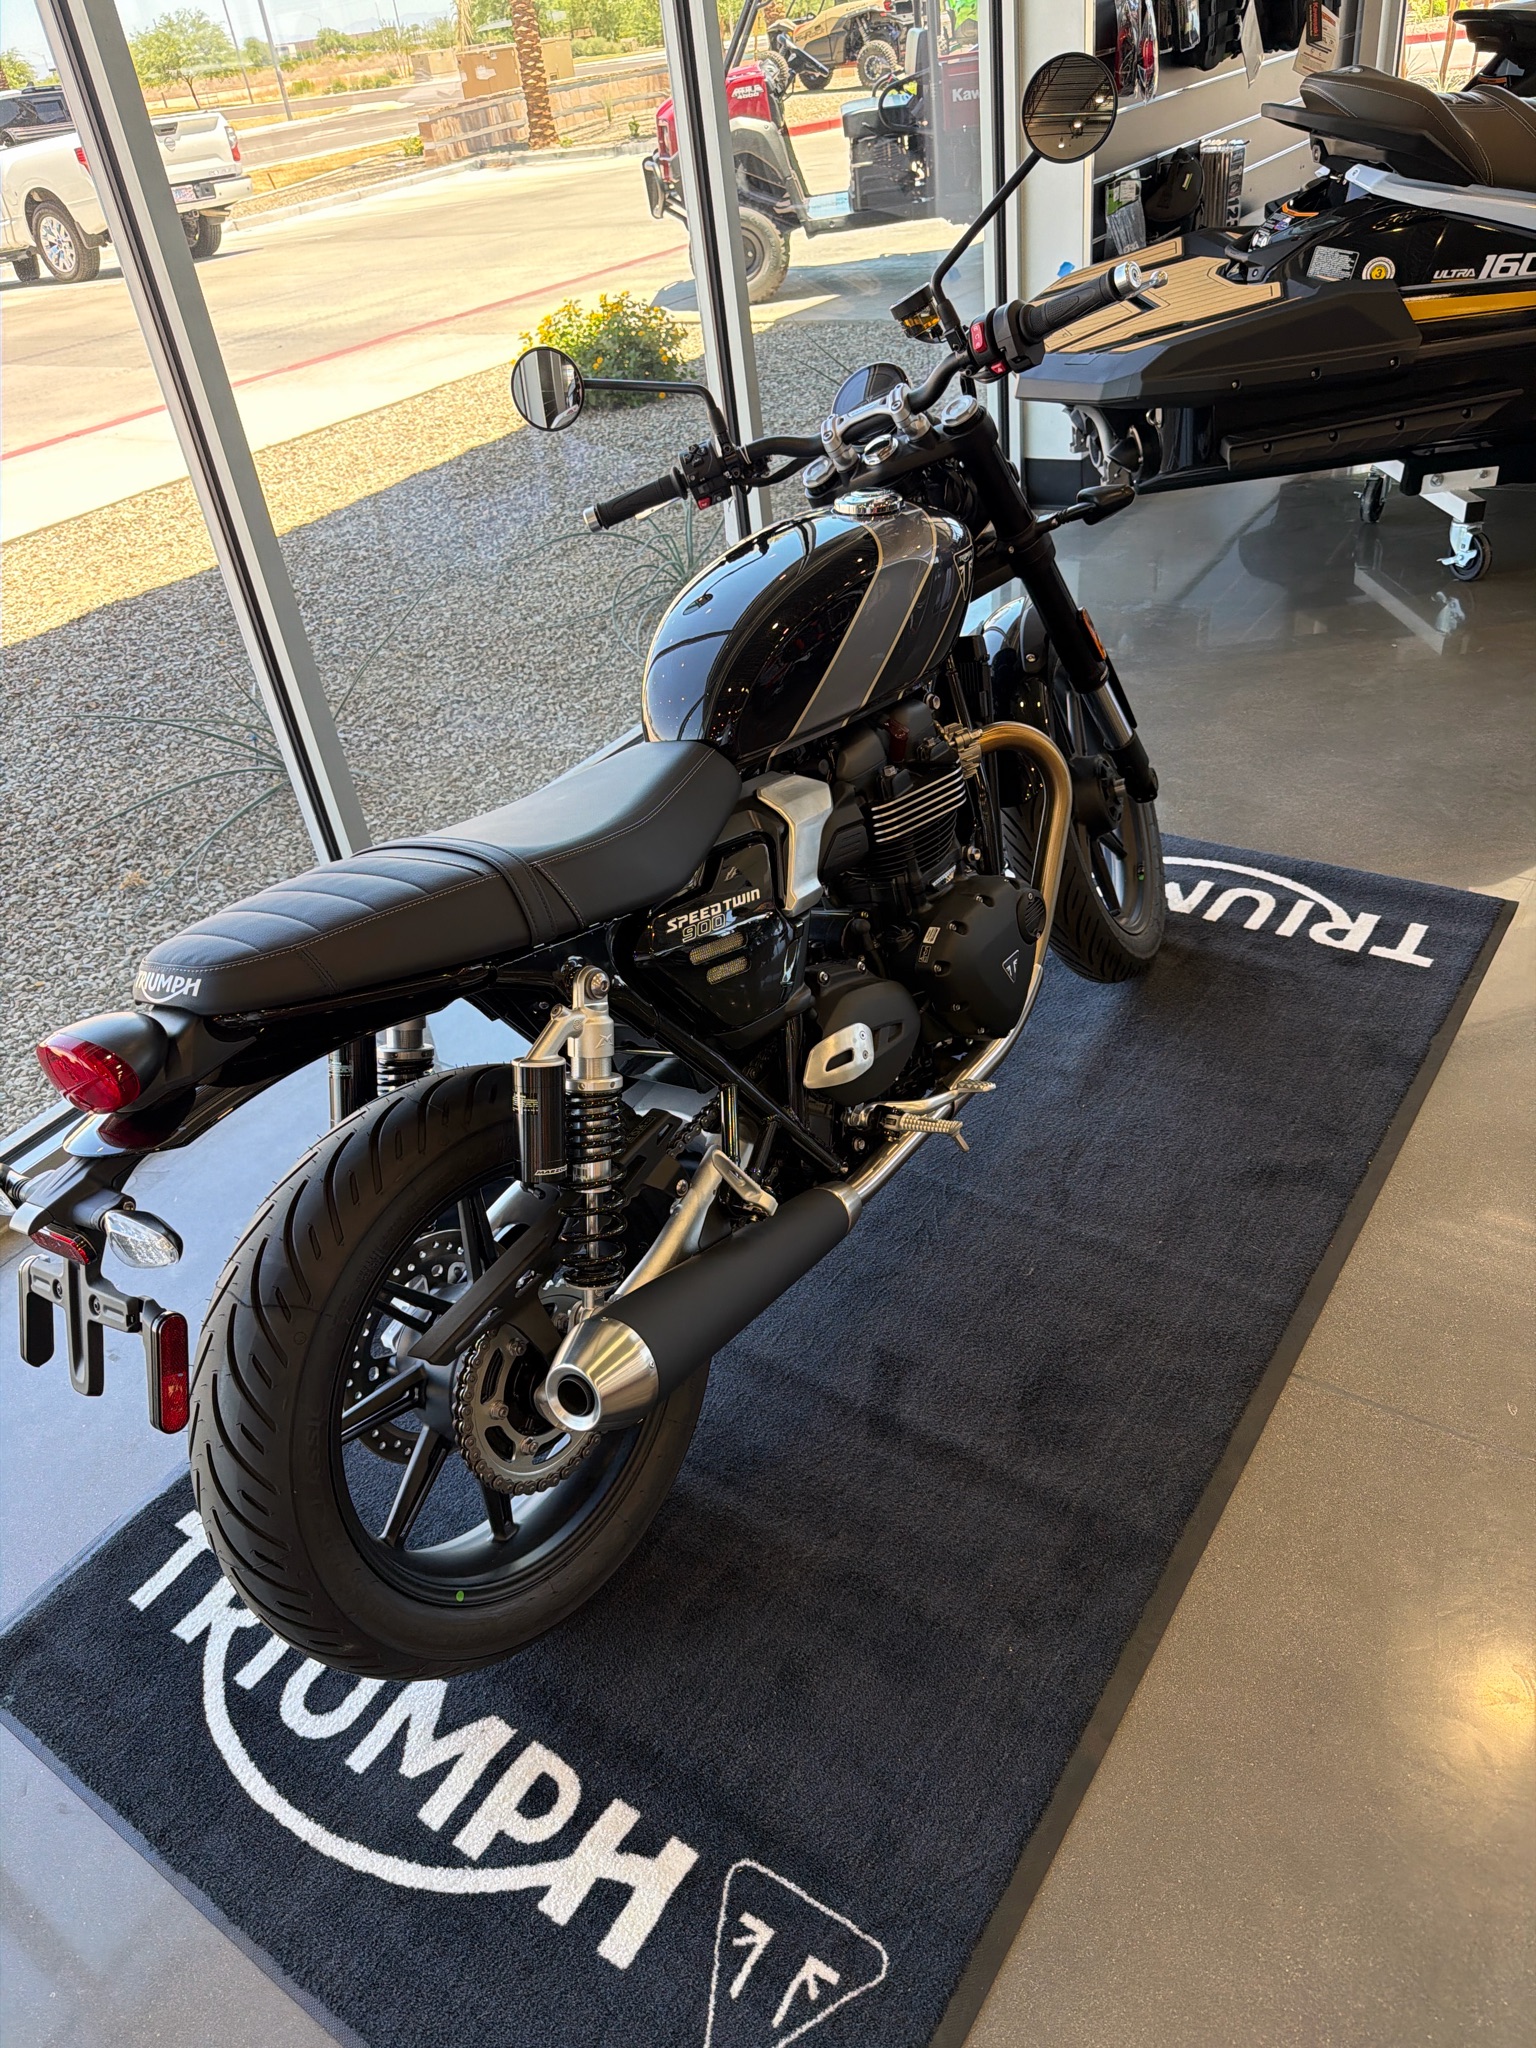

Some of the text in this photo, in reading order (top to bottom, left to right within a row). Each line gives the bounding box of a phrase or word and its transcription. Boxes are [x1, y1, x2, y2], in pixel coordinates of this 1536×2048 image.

[1375, 268, 1383, 278] 3
[1433, 268, 1476, 279] ULTRA
[666, 888, 761, 933] SPEED TWIN
[682, 913, 726, 943] 900
